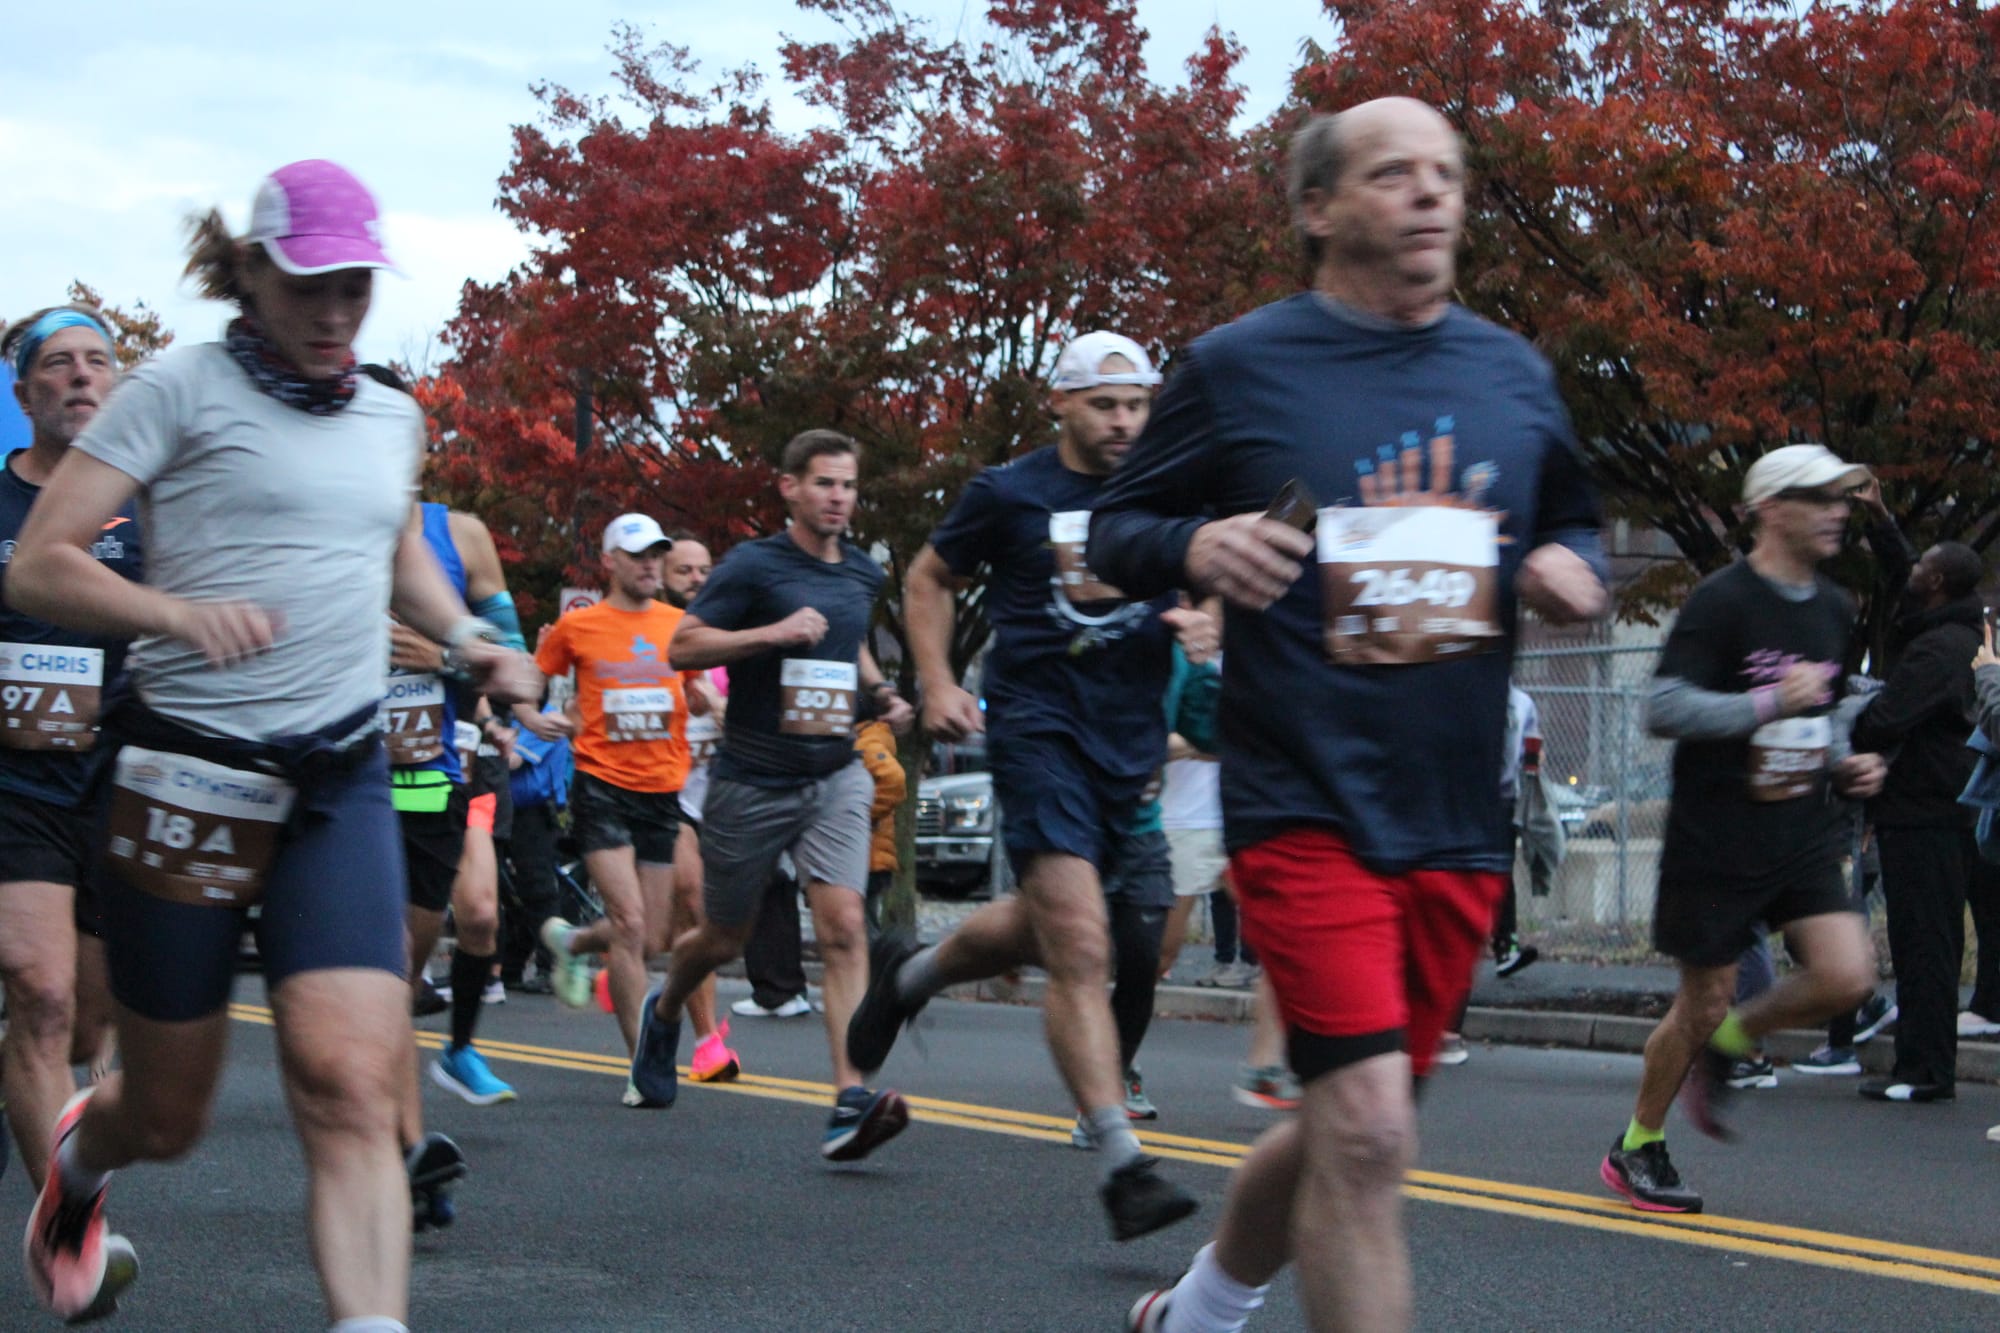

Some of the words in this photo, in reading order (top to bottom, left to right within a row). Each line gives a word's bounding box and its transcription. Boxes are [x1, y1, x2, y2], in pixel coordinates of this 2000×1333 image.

[1349, 568, 1476, 608] 2649
[21, 653, 89, 674] CHRIS
[1, 685, 45, 712] 97
[48, 688, 75, 714] A
[384, 682, 434, 700] JOHN
[415, 710, 433, 732] A
[146, 806, 196, 850] 18
[197, 824, 237, 855] A
